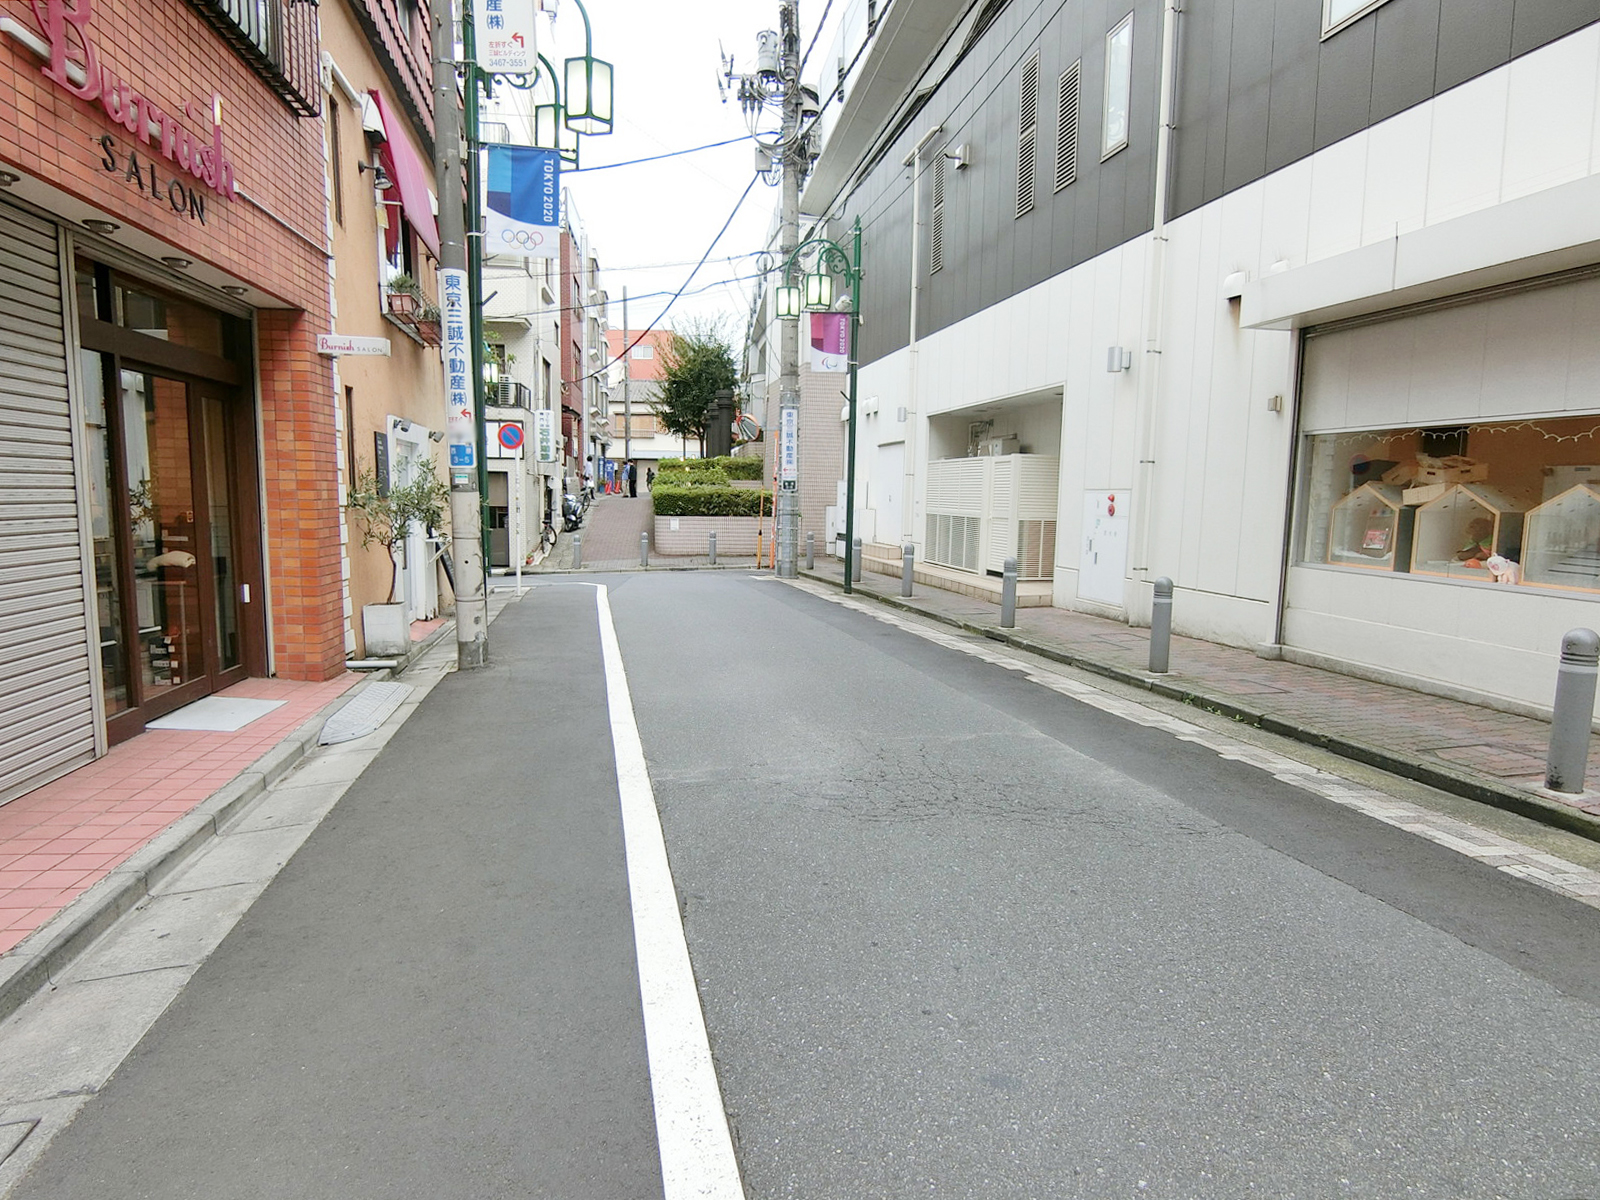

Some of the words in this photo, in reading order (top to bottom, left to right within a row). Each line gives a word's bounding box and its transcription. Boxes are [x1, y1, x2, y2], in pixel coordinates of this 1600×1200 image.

[489, 59, 527, 67] 3467-3551
[31, 0, 238, 202] Burnish
[100, 134, 206, 226] SALON
[543, 159, 554, 195] TOKYO
[543, 196, 554, 223] 2020
[319, 337, 355, 351] Burnish
